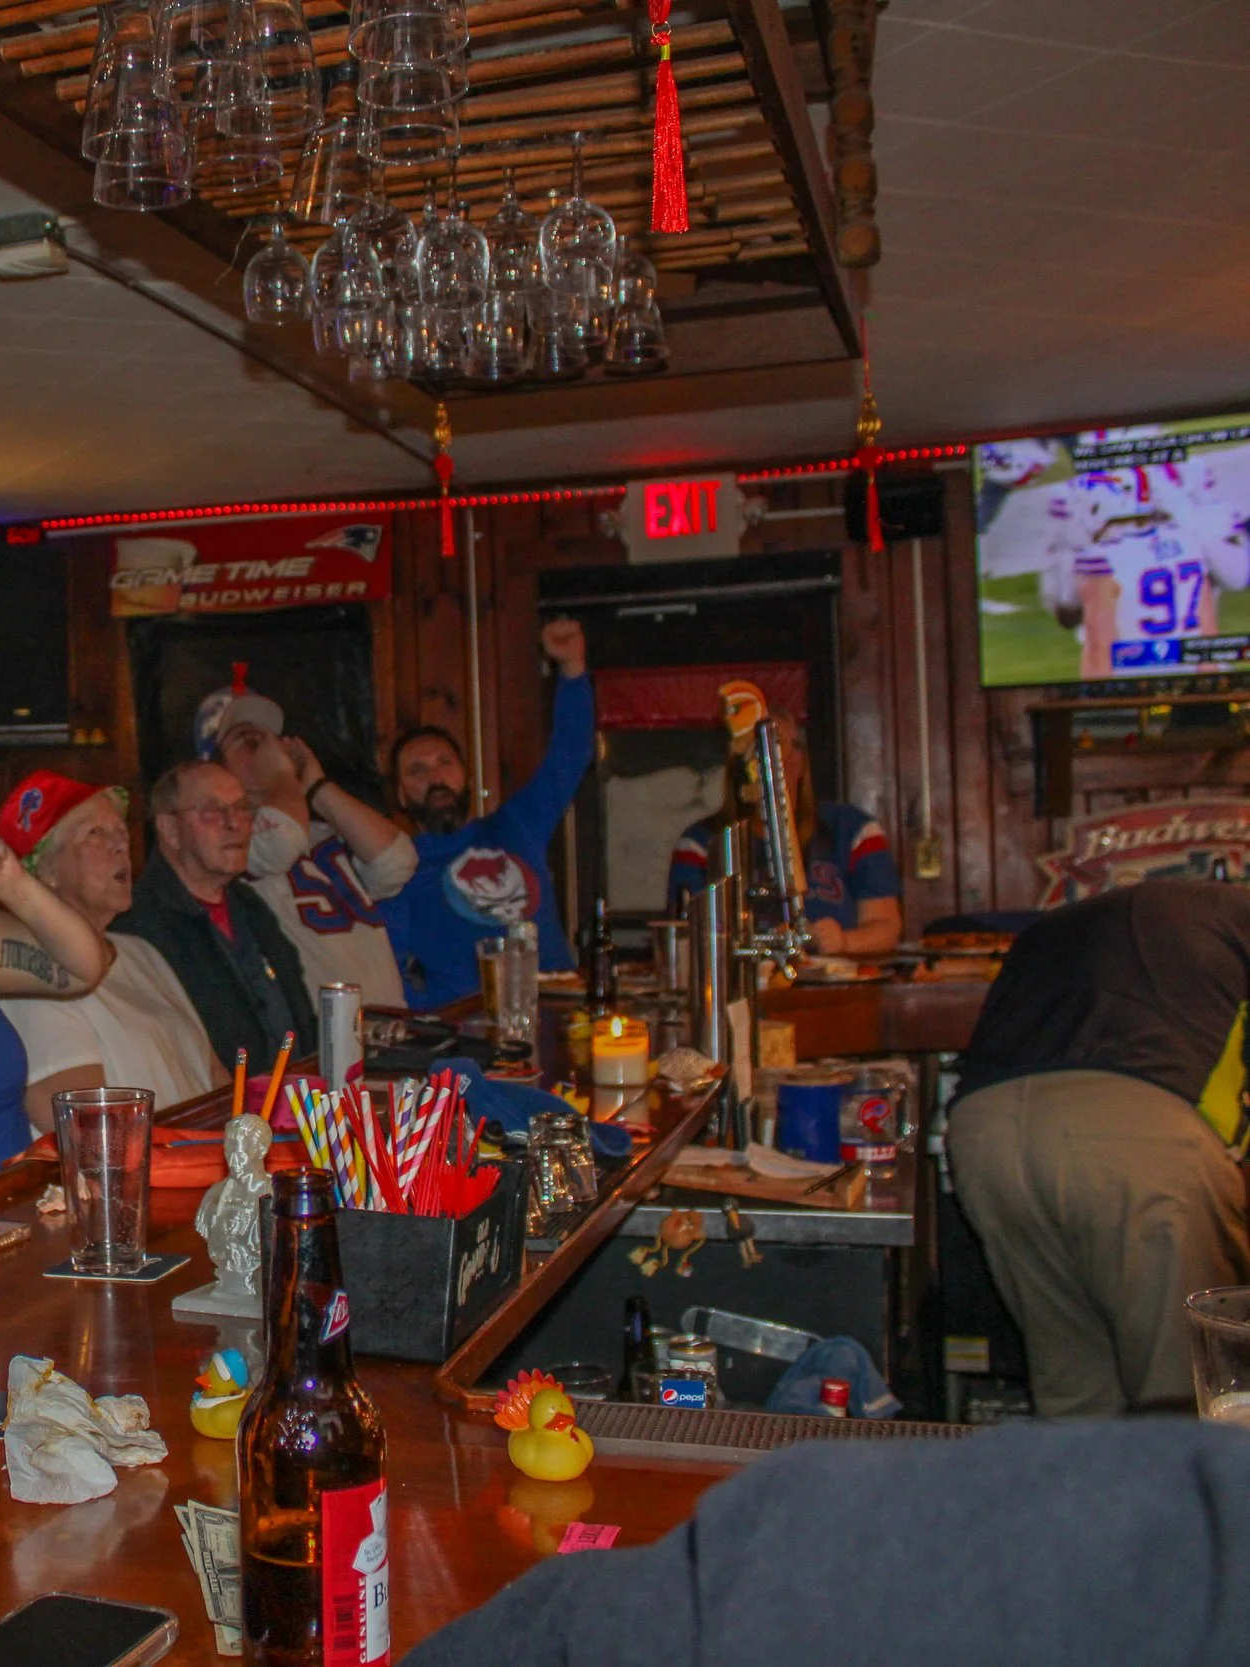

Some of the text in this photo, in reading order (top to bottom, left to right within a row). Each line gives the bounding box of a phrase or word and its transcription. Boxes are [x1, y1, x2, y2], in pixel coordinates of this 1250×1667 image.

[644, 479, 721, 539] EXIT
[111, 556, 314, 589] GAME TIME
[180, 580, 367, 606] BUDWEISER
[1138, 560, 1204, 635] 97
[679, 1393, 705, 1403] pepsi
[358, 1575, 367, 1664] GENUINE
